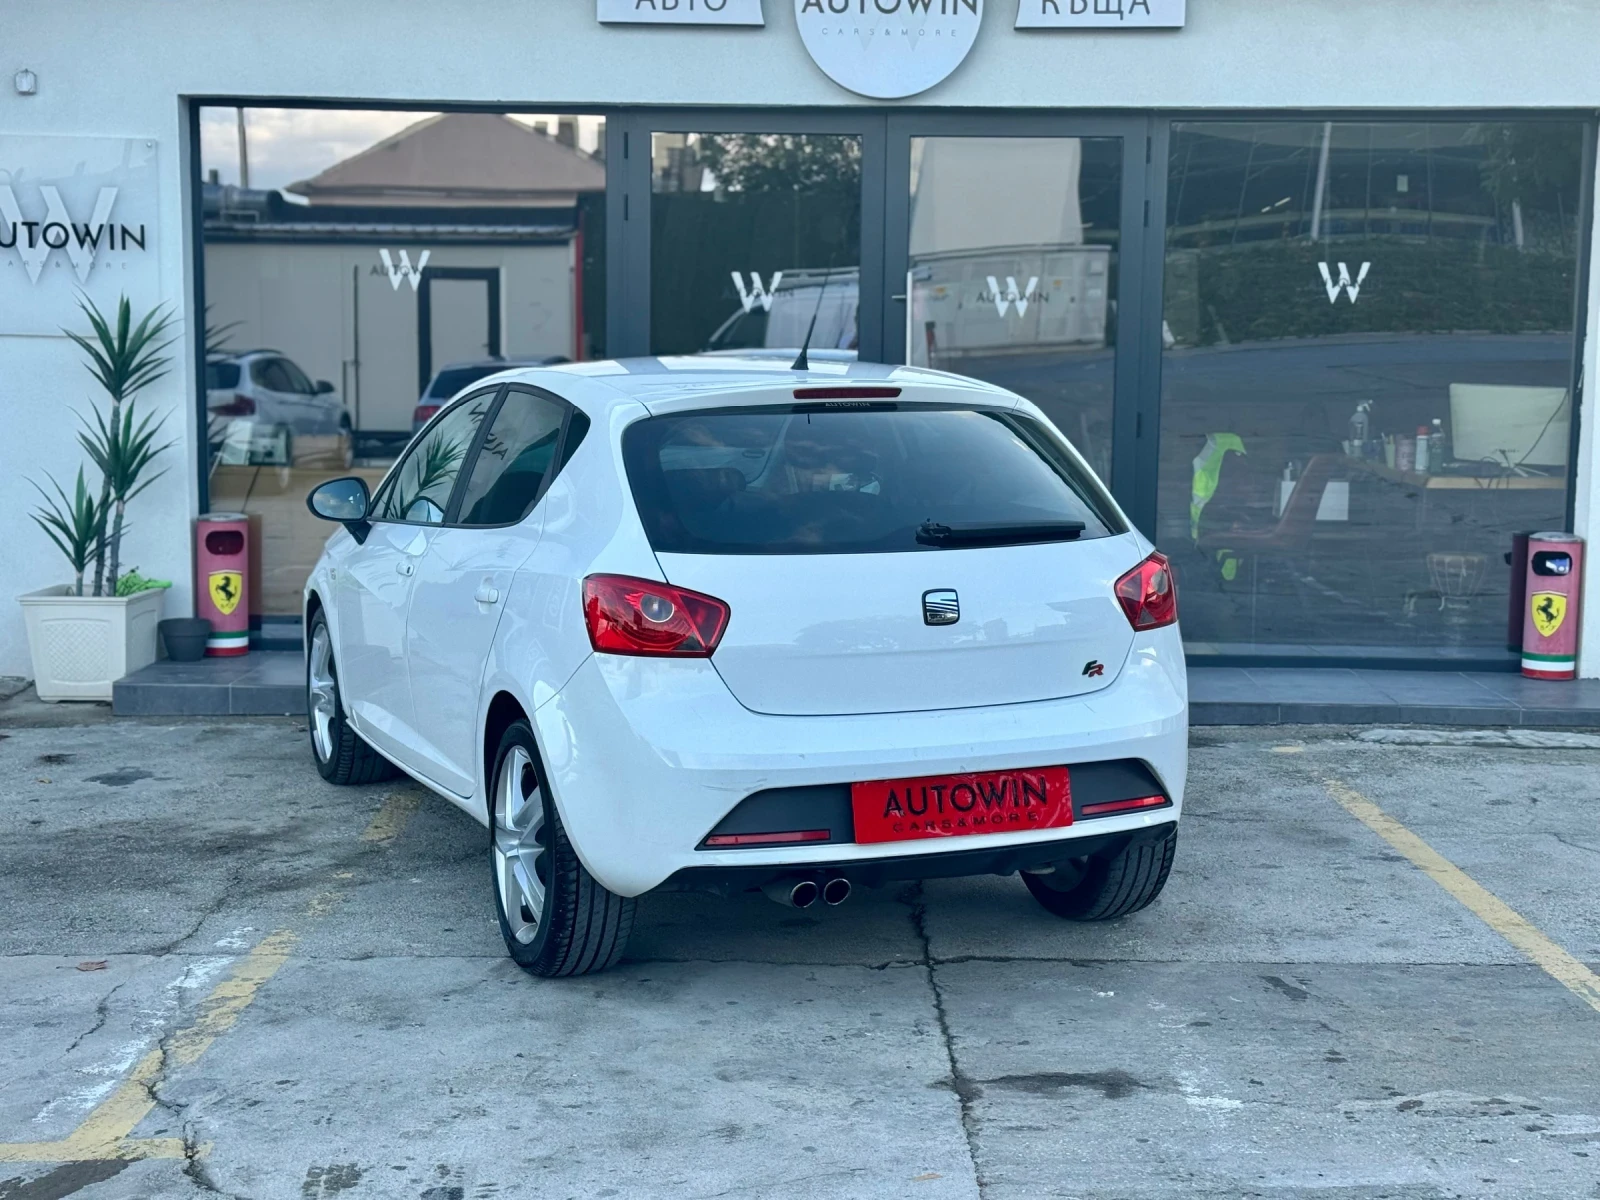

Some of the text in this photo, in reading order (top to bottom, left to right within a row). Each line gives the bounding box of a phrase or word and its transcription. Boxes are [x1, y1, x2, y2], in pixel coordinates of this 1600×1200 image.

[801, 0, 977, 15] AUTOWIN
[821, 27, 957, 37] CARS&MORE
[0, 221, 145, 251] UTOWIN
[379, 248, 431, 291] W
[731, 271, 783, 313] W
[986, 276, 1039, 318] W
[1082, 659, 1104, 678] FR
[884, 776, 1048, 819] AUTOWIN
[893, 811, 1038, 833] CARS&MORE
